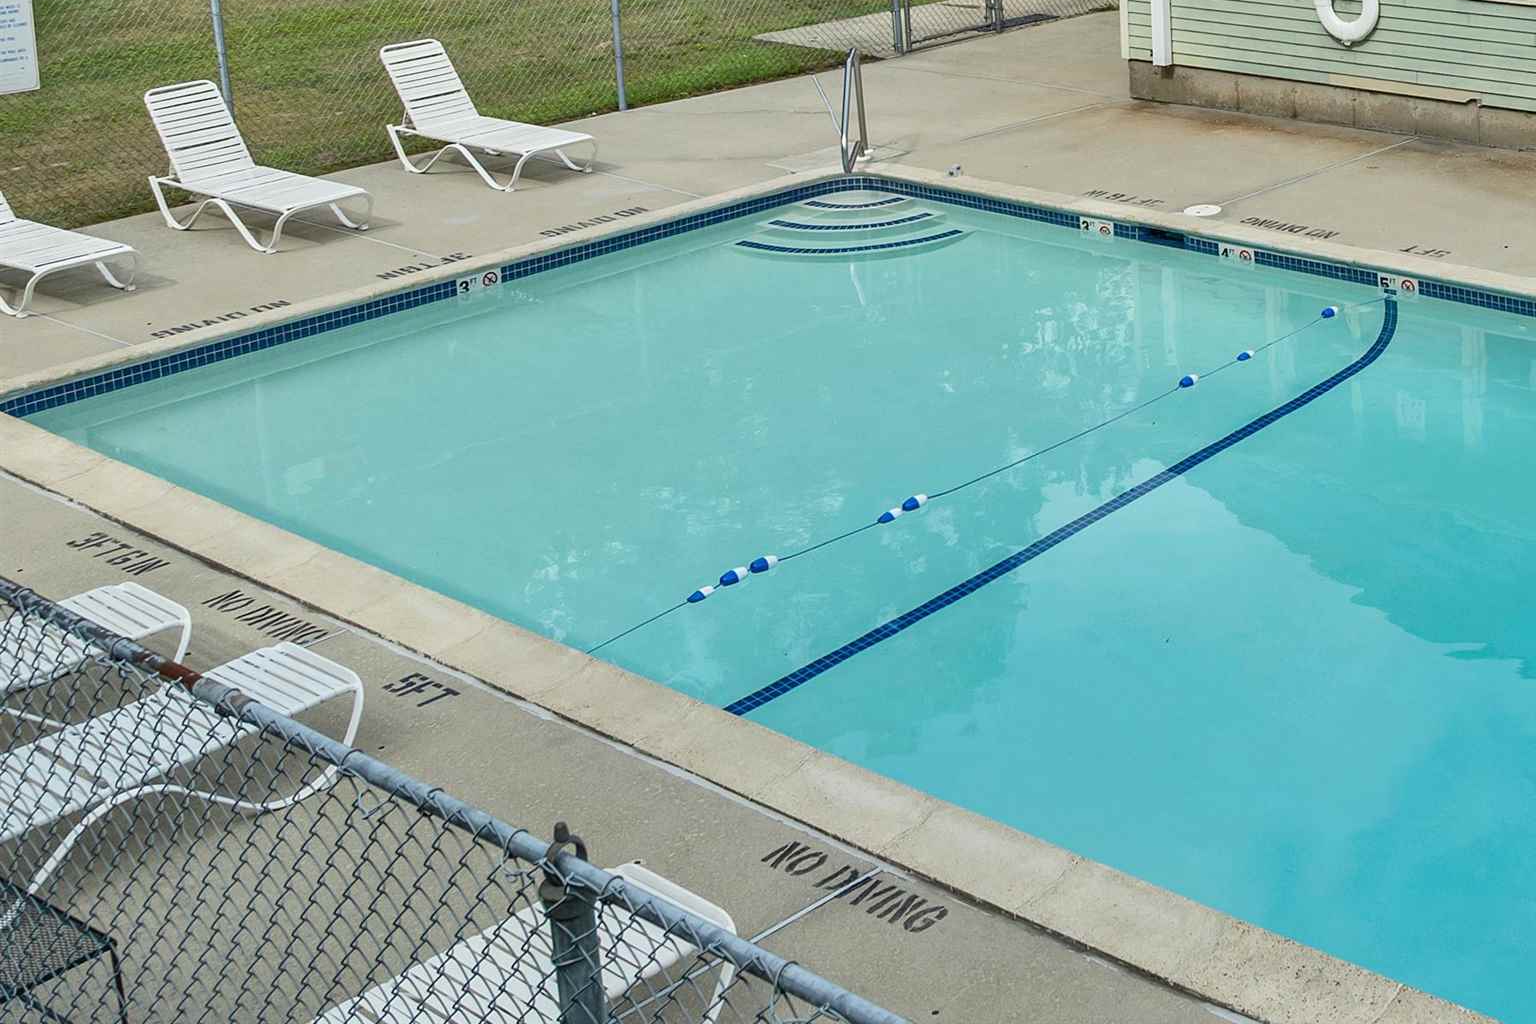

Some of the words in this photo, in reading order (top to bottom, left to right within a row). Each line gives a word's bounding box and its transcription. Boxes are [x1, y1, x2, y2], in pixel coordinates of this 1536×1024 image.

[614, 206, 649, 217] NO
[538, 215, 617, 238] DIVING
[1240, 216, 1309, 234] DIVING
[1305, 228, 1341, 239] NO
[250, 299, 292, 313] NO
[150, 311, 248, 339] DIVING
[200, 589, 257, 613] NO
[234, 604, 329, 645] DIVING
[382, 672, 461, 708] 5FT
[760, 841, 828, 876] NO
[812, 864, 949, 933] DIVING
